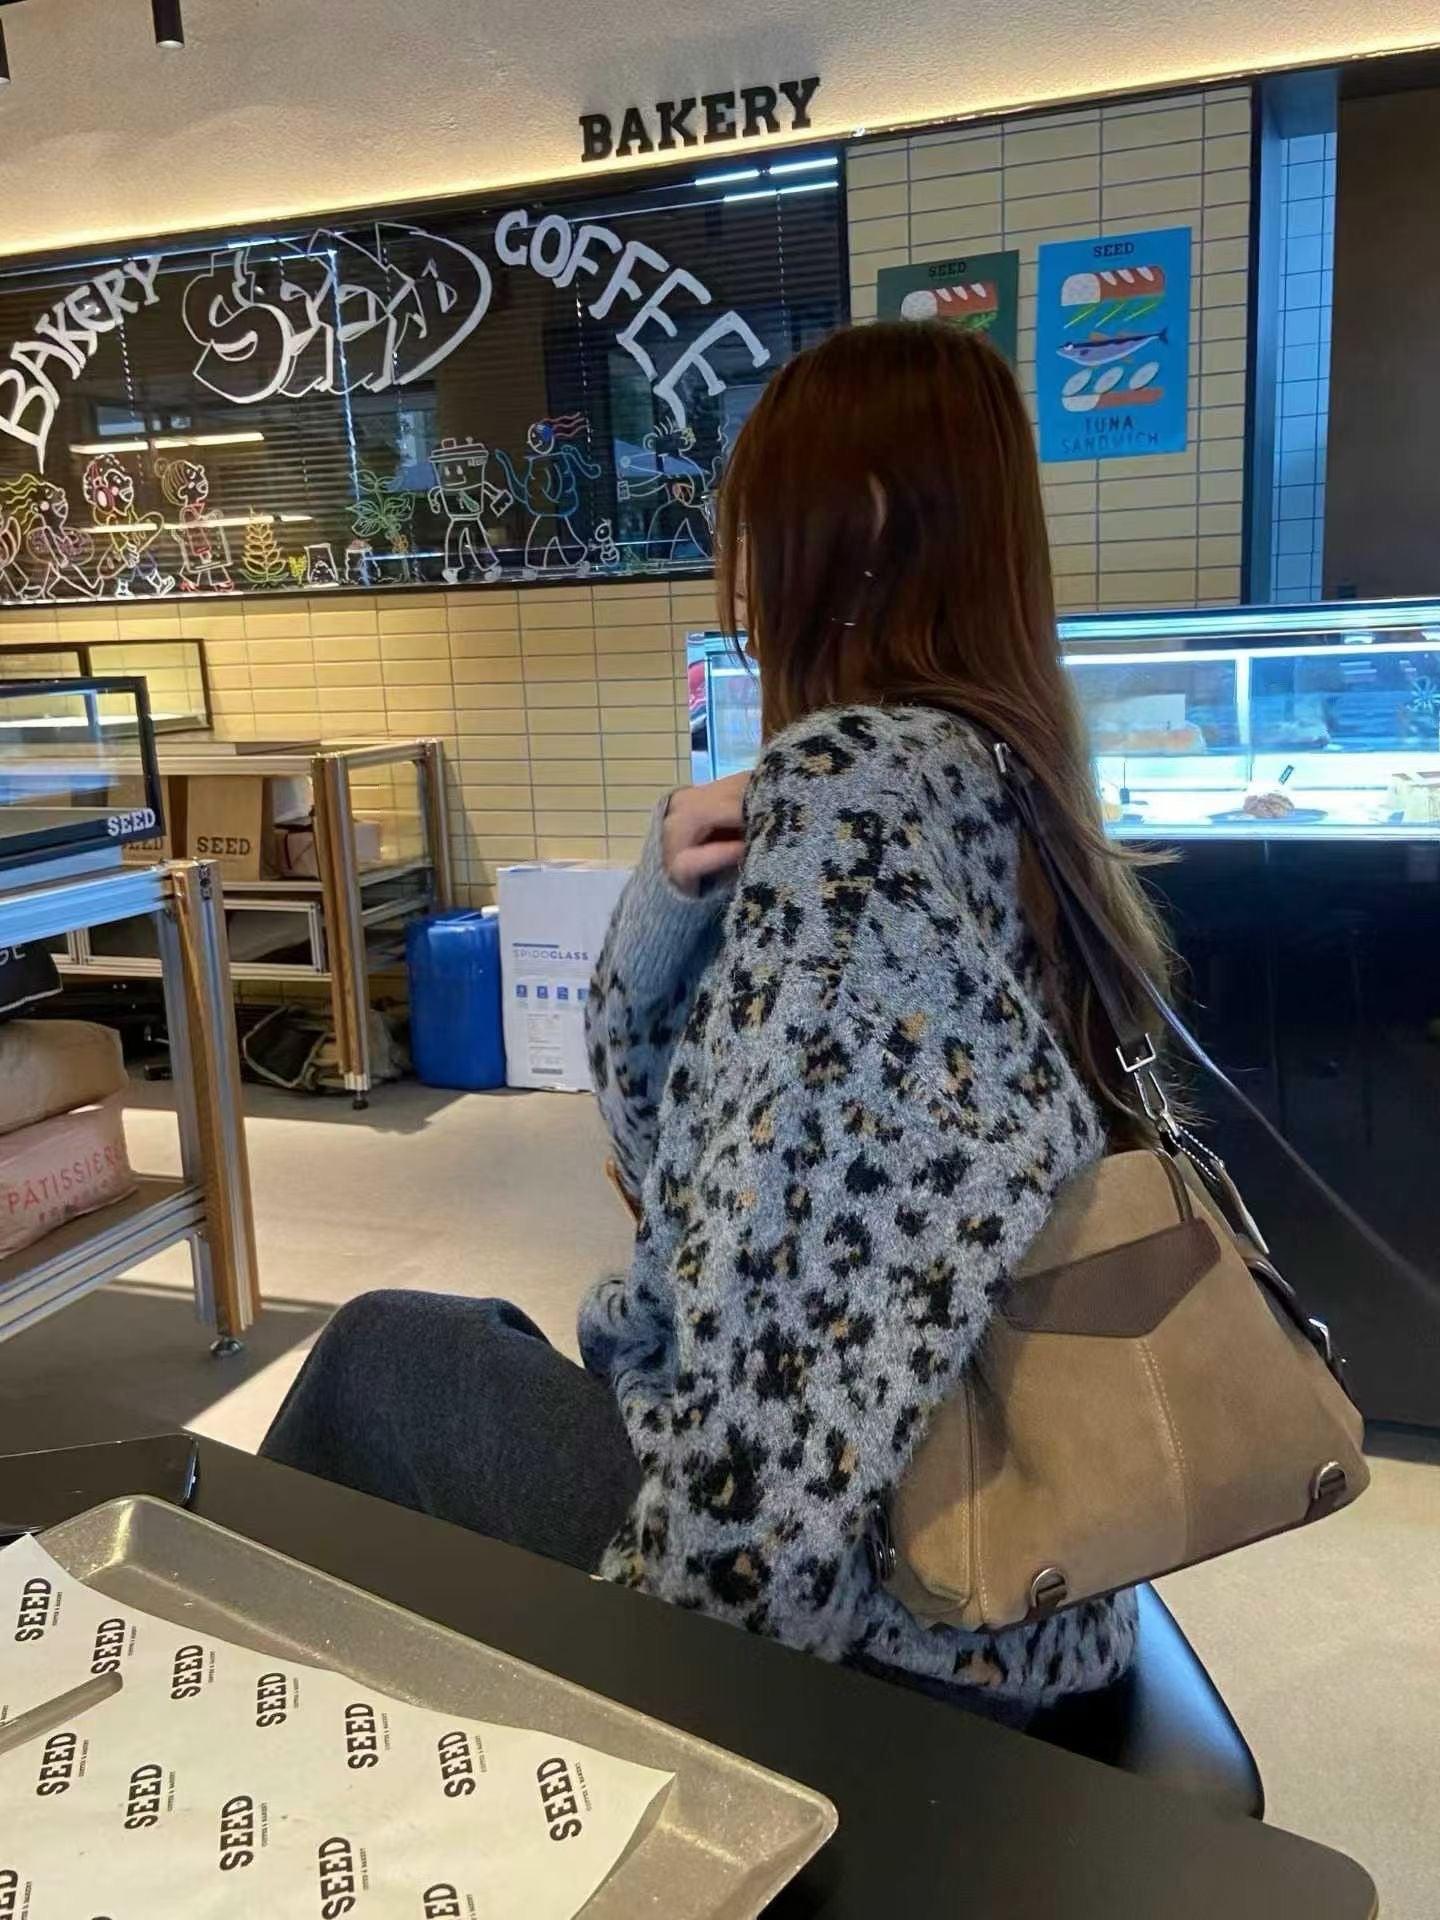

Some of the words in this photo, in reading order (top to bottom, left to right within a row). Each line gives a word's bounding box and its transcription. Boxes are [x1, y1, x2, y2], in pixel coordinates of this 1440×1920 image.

[579, 77, 820, 163] BAKERY
[928, 261, 967, 278] SEED
[1093, 242, 1135, 257] SEED
[495, 209, 771, 430] COFFEE
[0, 256, 162, 475] BAKERY
[1085, 415, 1134, 433] TUNA
[107, 808, 156, 836] SEED
[197, 836, 251, 856] SEED
[15, 1577, 52, 1642] SEED
[90, 1618, 126, 1674] SEED
[170, 1644, 204, 1700] SEED
[256, 1672, 288, 1728] SEED
[36, 1732, 77, 1797] SEED
[344, 1703, 379, 1770] SEED
[437, 1730, 477, 1798] SEED
[123, 1763, 162, 1830] SEED
[536, 1757, 583, 1842] SEED
[219, 1795, 255, 1872] SEED
[318, 1836, 357, 1920] SEED
[423, 1882, 461, 1920] ED
